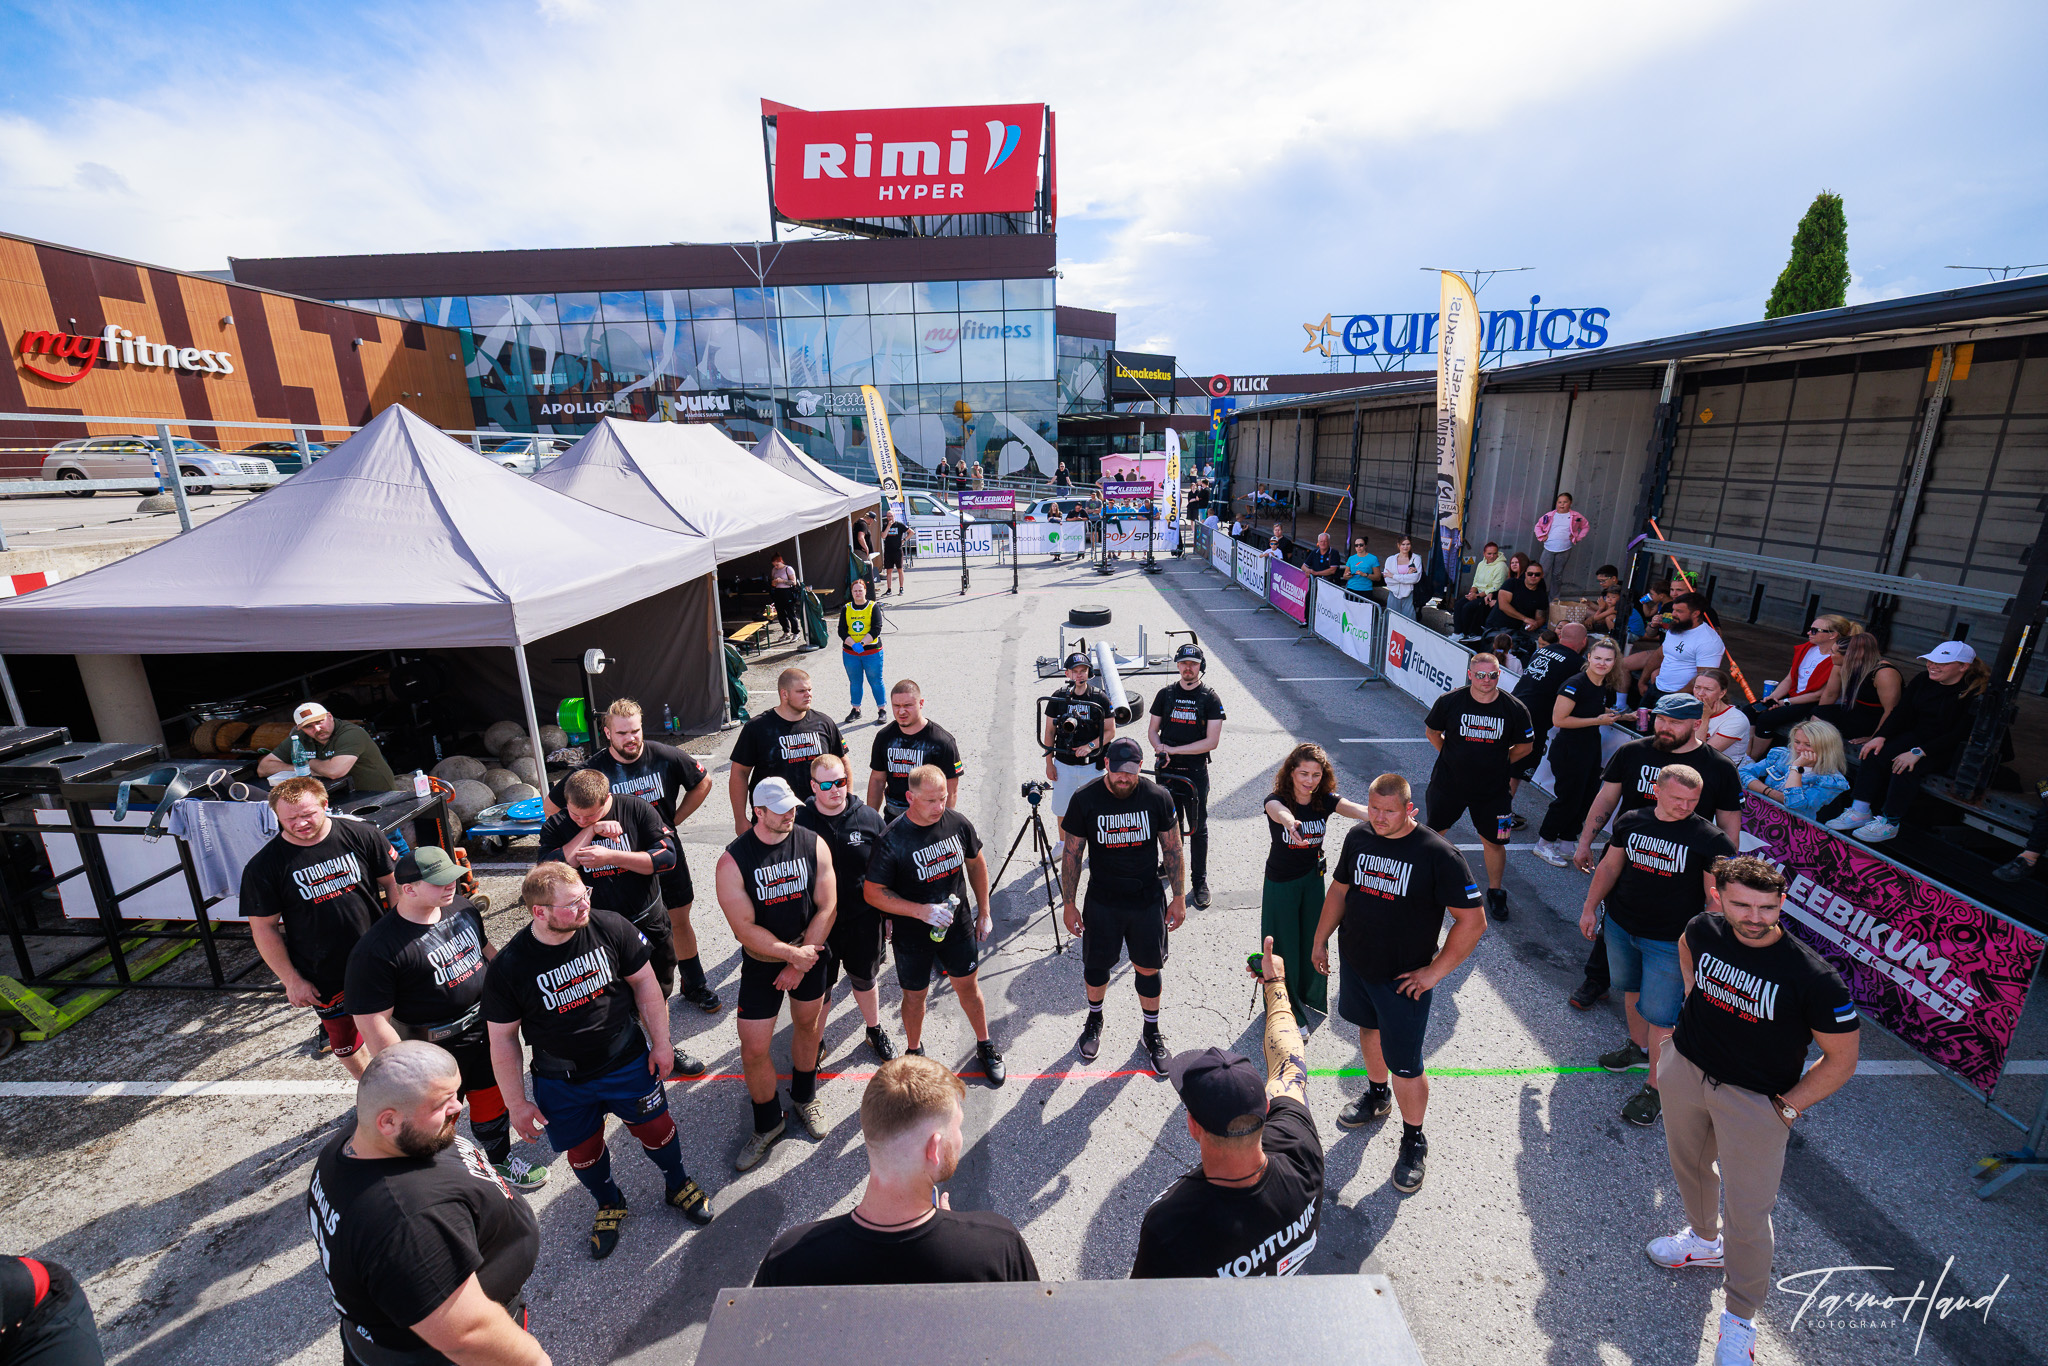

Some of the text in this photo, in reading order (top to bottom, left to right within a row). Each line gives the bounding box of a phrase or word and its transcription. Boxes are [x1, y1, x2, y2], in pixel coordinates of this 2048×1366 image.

[879, 183, 964, 200] HYPER
[1342, 295, 1611, 356] eurnics
[1115, 365, 1172, 381] Lõunakeskus
[1233, 377, 1269, 392] KLICK
[541, 402, 605, 414] APOLLO
[824, 393, 866, 406] Betta
[975, 495, 1013, 504] KLEEBIKUM
[1118, 486, 1152, 494] KLEEBIKUM
[936, 540, 990, 553] HALDUS
[1134, 533, 1168, 541] SPOR
[1243, 549, 1258, 570] EESTI
[1280, 577, 1306, 602] KLEEBIKUM
[1460, 714, 1504, 731] STRONGMAN
[779, 732, 822, 750] STRONGMAN
[887, 748, 924, 766] STRONGMAN
[1097, 810, 1150, 834] STRONGMAN
[1098, 826, 1150, 844] STRONGWOMAN
[913, 834, 963, 866] STRONGMAN
[1106, 841, 1130, 849] ESTONIA
[1627, 833, 1688, 862] STRONGMAN
[1649, 850, 1659, 858] PRO
[293, 852, 361, 884] STRONGMAN
[917, 850, 964, 882] STRONGWOMAN
[1355, 854, 1412, 883] STRONGMAN
[1626, 848, 1687, 873] STRONGWOMAN
[1632, 863, 1655, 874] ESTONIA
[754, 857, 807, 888] STRONGMAN
[927, 871, 949, 883] ESTONIA
[298, 874, 361, 900] STRONGWOMAN
[757, 874, 808, 901] STRONGWOMAN
[1360, 885, 1394, 901] ESTONIA 2026
[314, 890, 343, 904] ESTONIA
[765, 896, 788, 906] ESTONIA
[1757, 851, 1981, 1007] EEBIKUM.EE
[427, 927, 482, 970] STRONGMAN
[448, 969, 474, 988] ESTONIA
[536, 947, 612, 993] STRONGMAN
[1696, 952, 1779, 1005] STRONGMAN
[1841, 936, 1956, 1017] REKLAAM
[542, 969, 612, 1011] STRONGWOMAN
[571, 975, 583, 986] PRO
[1723, 983, 1737, 994] PRO
[558, 995, 590, 1014] ESTONIA
[1695, 976, 1776, 1021] STRONGWOMAN
[1703, 992, 1758, 1023] ESTONIA 2026
[1217, 1196, 1317, 1278] KOHTUNIK
